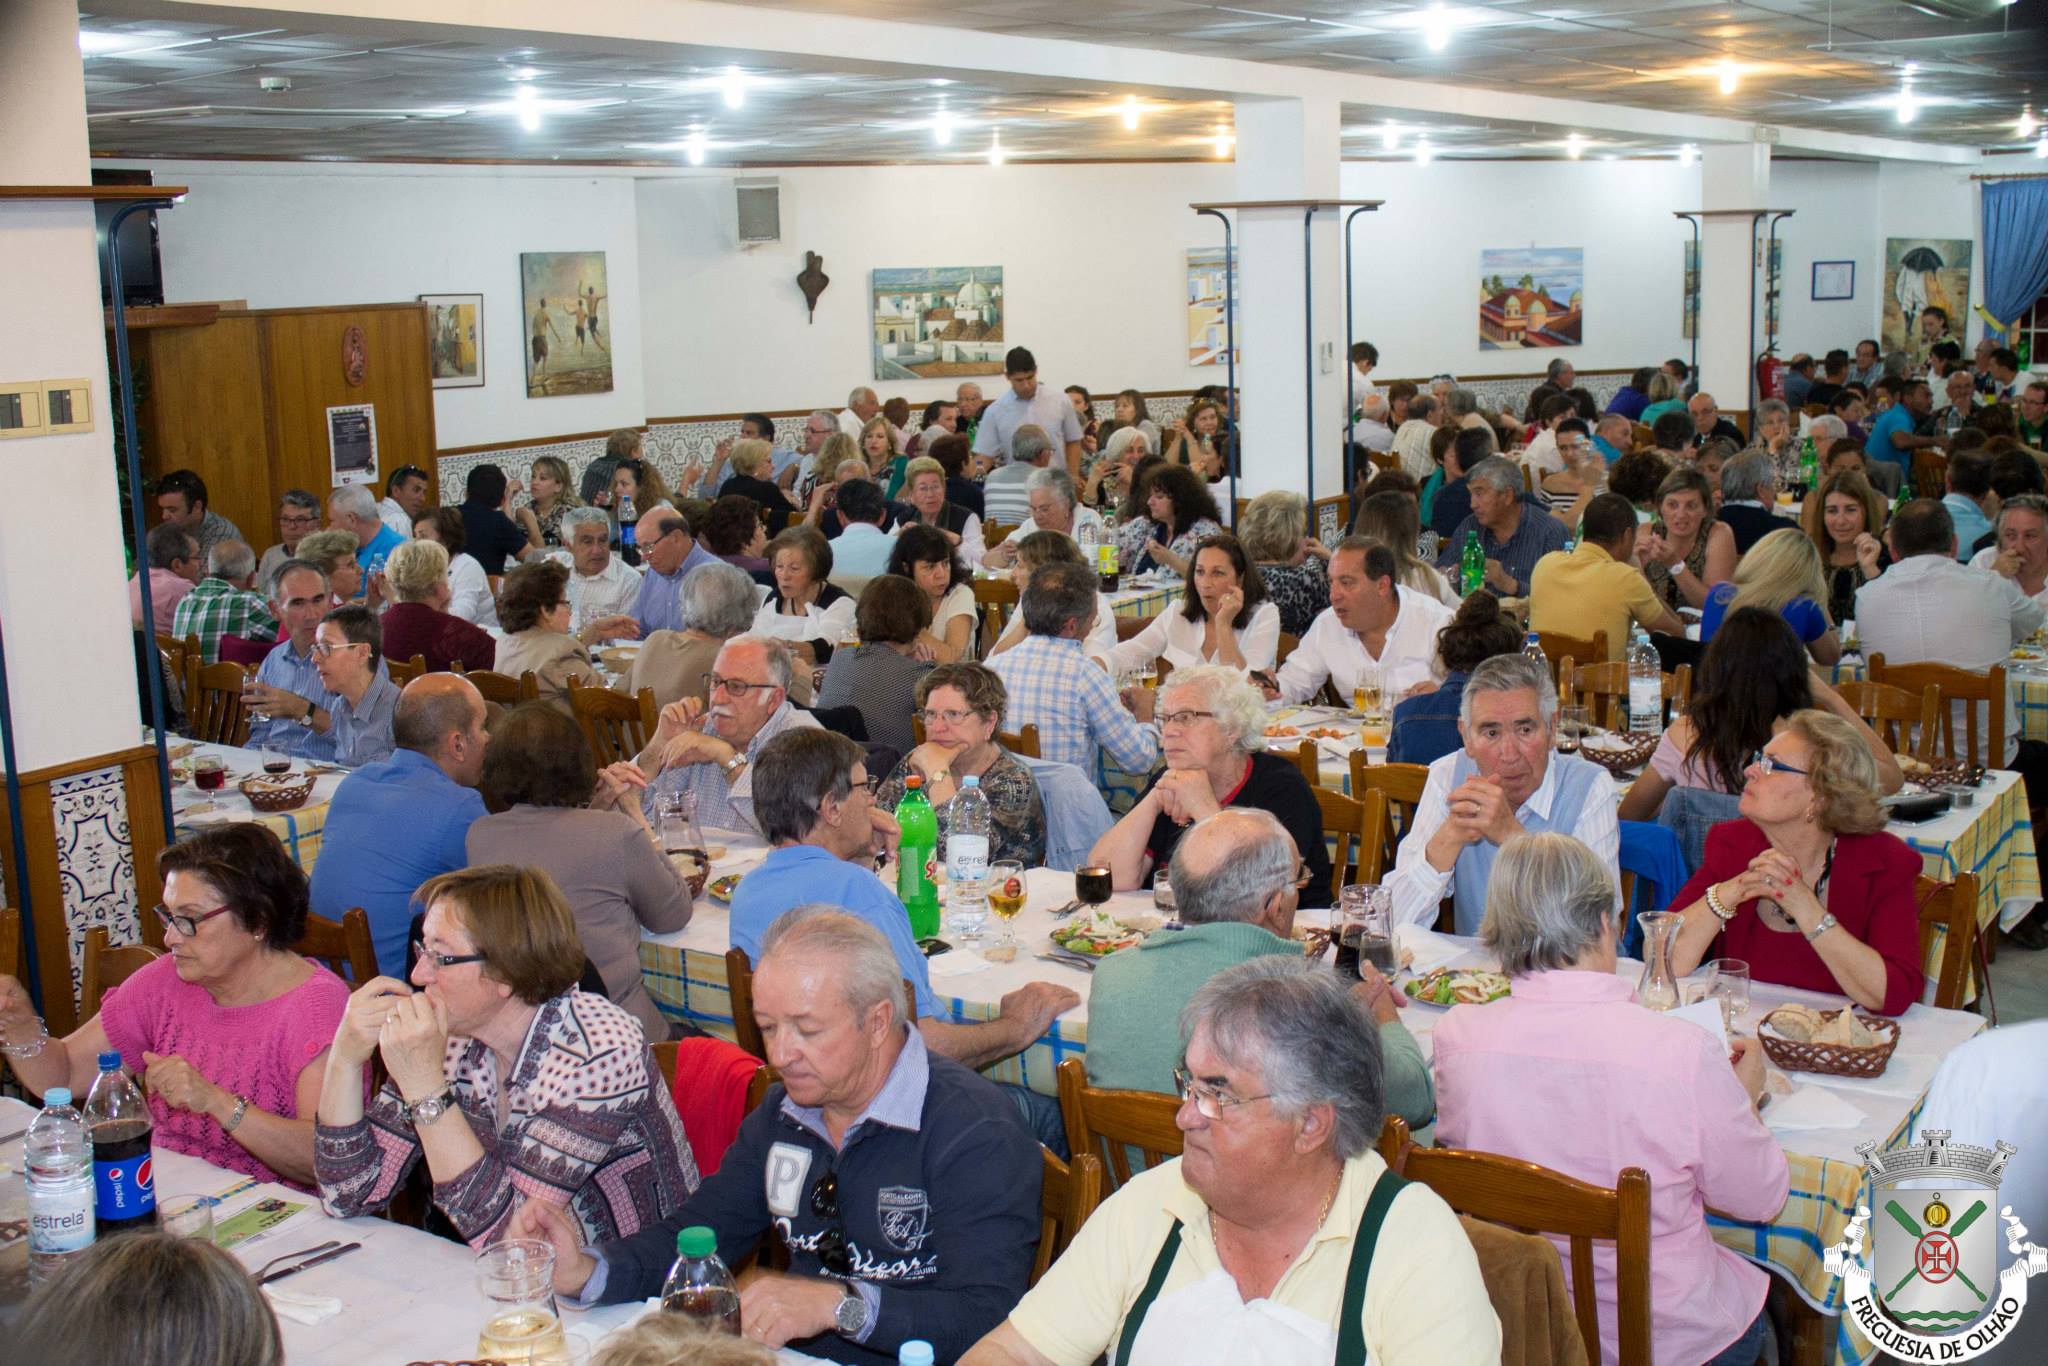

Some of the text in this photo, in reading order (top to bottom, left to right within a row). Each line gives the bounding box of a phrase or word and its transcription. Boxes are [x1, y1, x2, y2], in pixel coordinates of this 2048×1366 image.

[771, 1156, 800, 1201] P
[112, 1182, 126, 1208] pepsi
[32, 1211, 85, 1229] estrela
